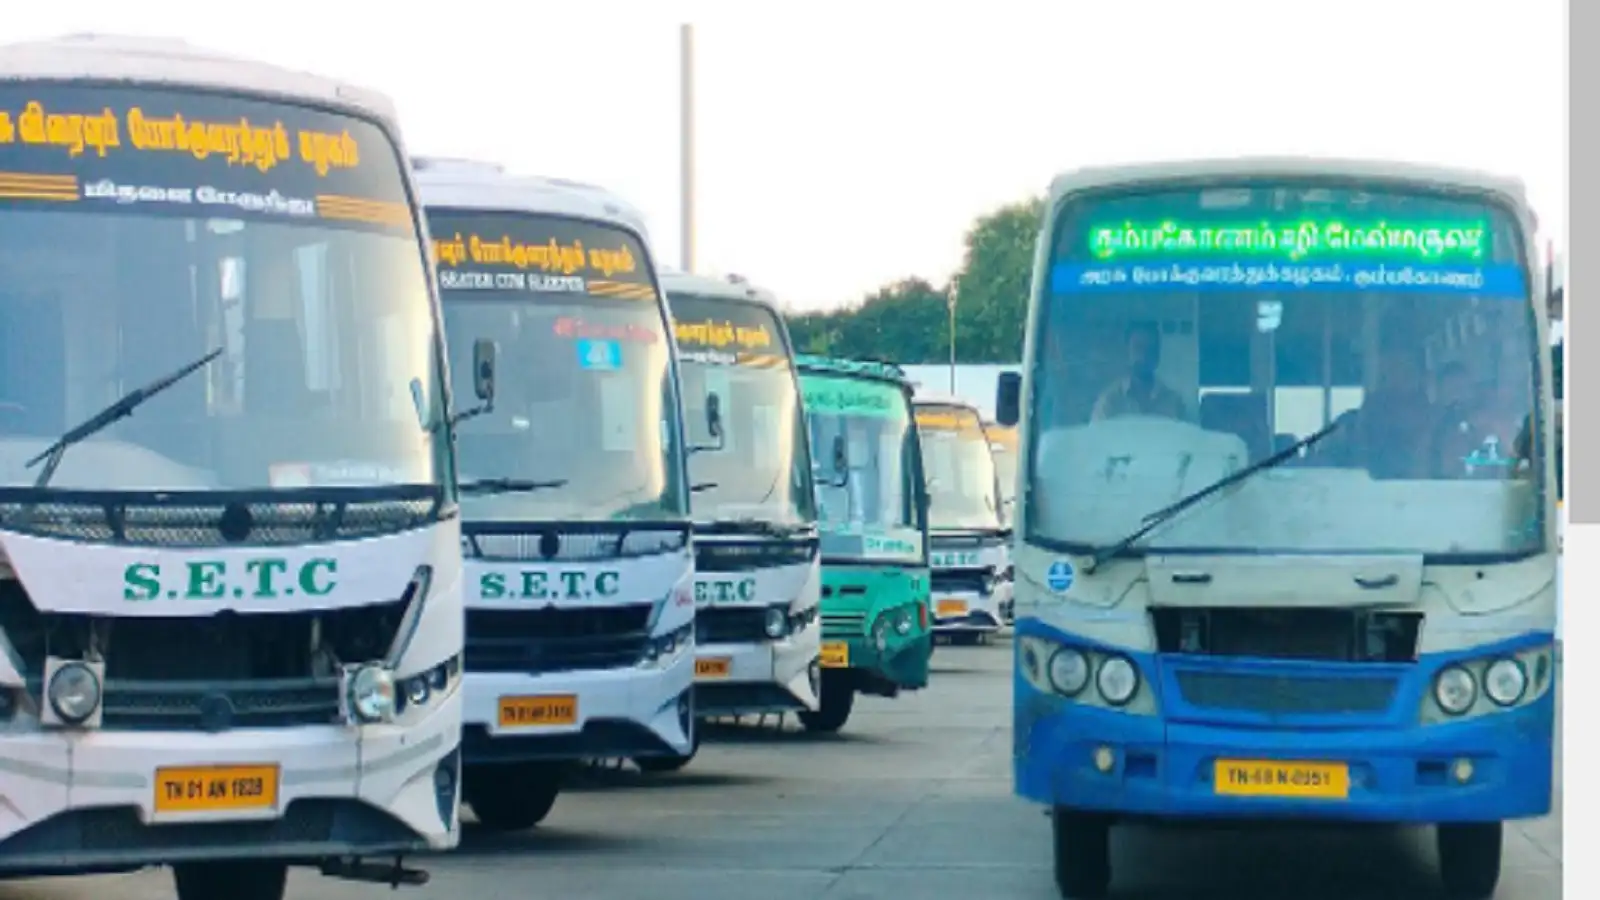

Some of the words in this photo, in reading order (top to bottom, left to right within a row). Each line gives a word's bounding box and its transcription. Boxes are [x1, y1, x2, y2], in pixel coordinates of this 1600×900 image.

[440, 270, 494, 290] SEATER
[495, 272, 526, 290] CUM
[528, 272, 585, 292] SLEEPER
[123, 557, 338, 602] S.E.T.C
[479, 570, 620, 599] S.E.T.C
[695, 579, 756, 602] E.T.C
[207, 779, 227, 799] AN
